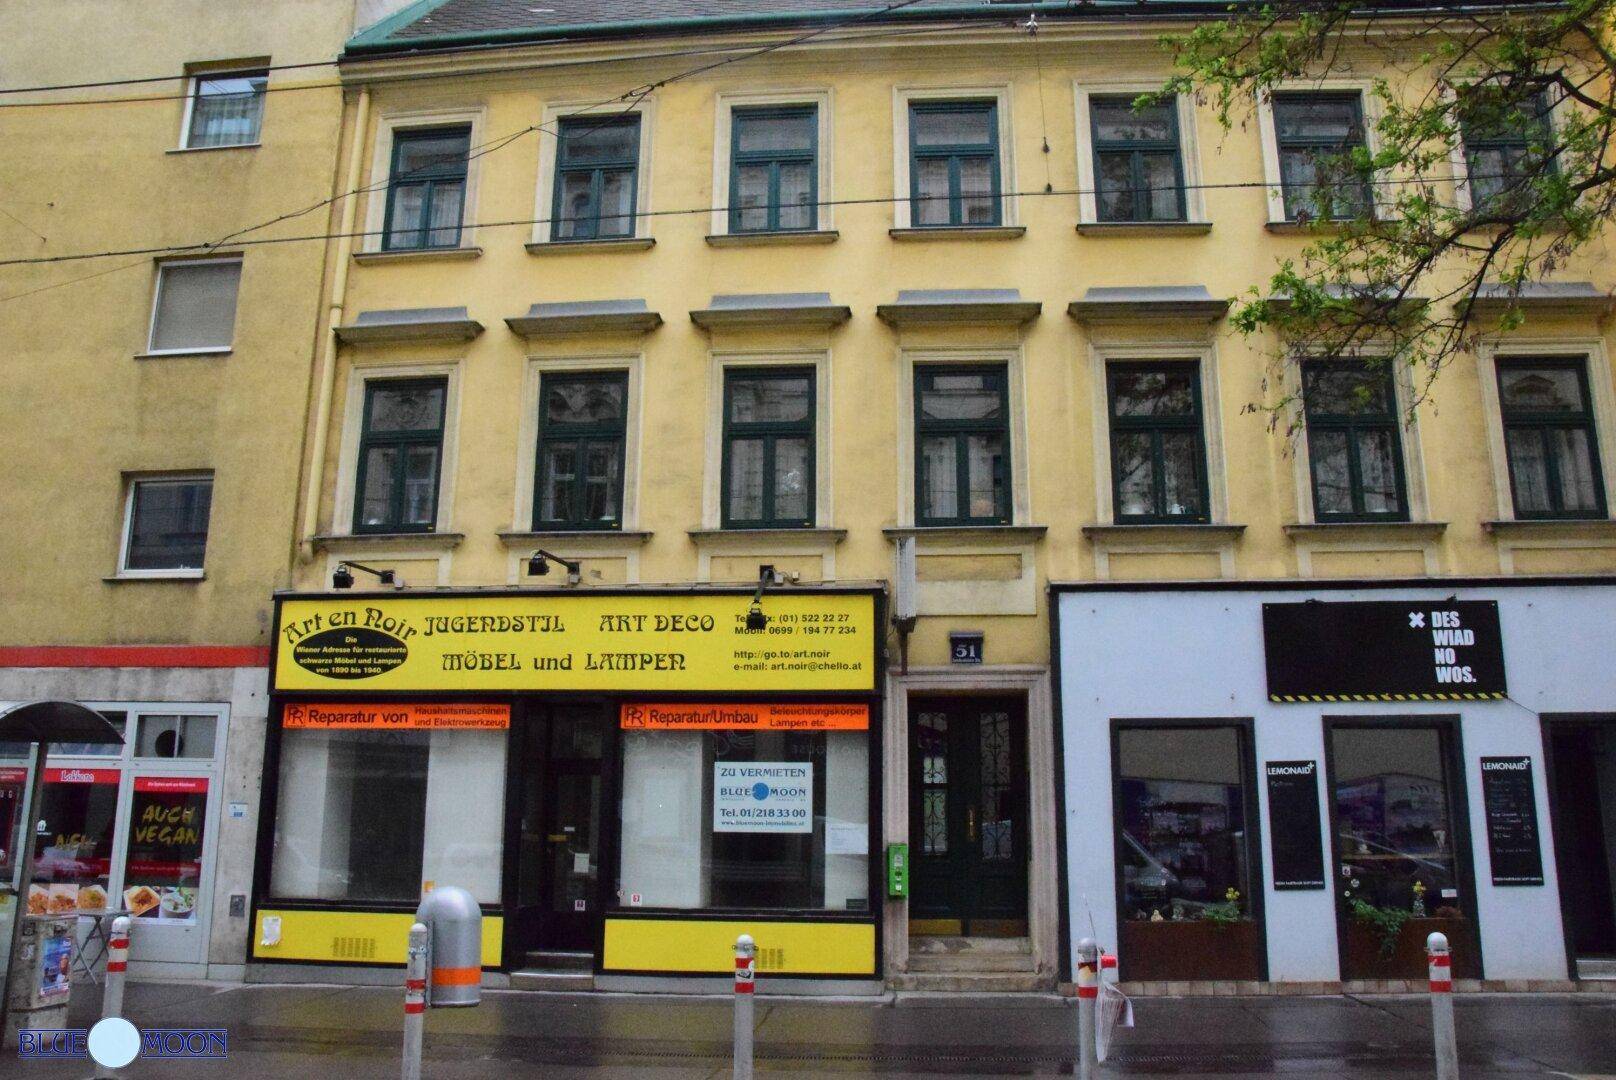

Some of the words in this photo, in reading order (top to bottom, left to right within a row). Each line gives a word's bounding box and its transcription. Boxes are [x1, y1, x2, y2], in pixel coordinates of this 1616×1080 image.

[599, 614, 648, 632] ART
[654, 614, 715, 632] DECO
[779, 614, 799, 624] (01)
[801, 614, 820, 623] 522
[822, 614, 835, 623] 22
[837, 614, 850, 623] 27
[1431, 610, 1460, 628] DES
[282, 612, 322, 644] Art
[328, 610, 357, 627] en
[363, 607, 418, 640] Noir
[423, 615, 565, 636] JUGENDSTIL
[768, 626, 794, 635] 0699
[795, 626, 800, 635] /
[802, 626, 821, 635] 194
[823, 626, 836, 635] 77
[838, 626, 857, 635] 234
[1432, 629, 1475, 646] WIAD
[322, 645, 351, 653] Adresse
[352, 645, 364, 653] für
[955, 644, 975, 658] 51
[442, 650, 522, 671] MÖBEL
[533, 653, 572, 671] und
[584, 653, 686, 671] LAMPEN
[734, 650, 831, 660] http://go.to/art.noir
[1434, 647, 1456, 664] NO
[373, 657, 402, 666] Lampen
[734, 662, 768, 671] e-mail:
[770, 662, 862, 671] art.noir@chello.at
[331, 665, 349, 673] 1890
[350, 665, 362, 673] bis
[363, 665, 382, 673] 1940
[1435, 666, 1477, 683] WOS.
[415, 706, 507, 715] Haushaltsmaschinen
[770, 706, 866, 717] Beleuchtungskörper
[309, 709, 378, 726] Reparatur
[381, 711, 409, 724] von
[414, 718, 432, 726] und
[434, 718, 507, 728] Elektrowerkzeug
[650, 709, 759, 726] Reparatur/Umbau
[770, 719, 808, 728] Lampen
[810, 719, 826, 727] etc
[720, 768, 736, 777] ZU
[740, 768, 806, 777] VERMIETEN
[720, 787, 752, 796] BLUE
[769, 788, 806, 797] MOON
[142, 804, 196, 824] AUCH
[720, 808, 738, 818] Tel.
[776, 809, 790, 818] 33
[792, 809, 806, 818] 00
[134, 826, 200, 845] VEGAN
